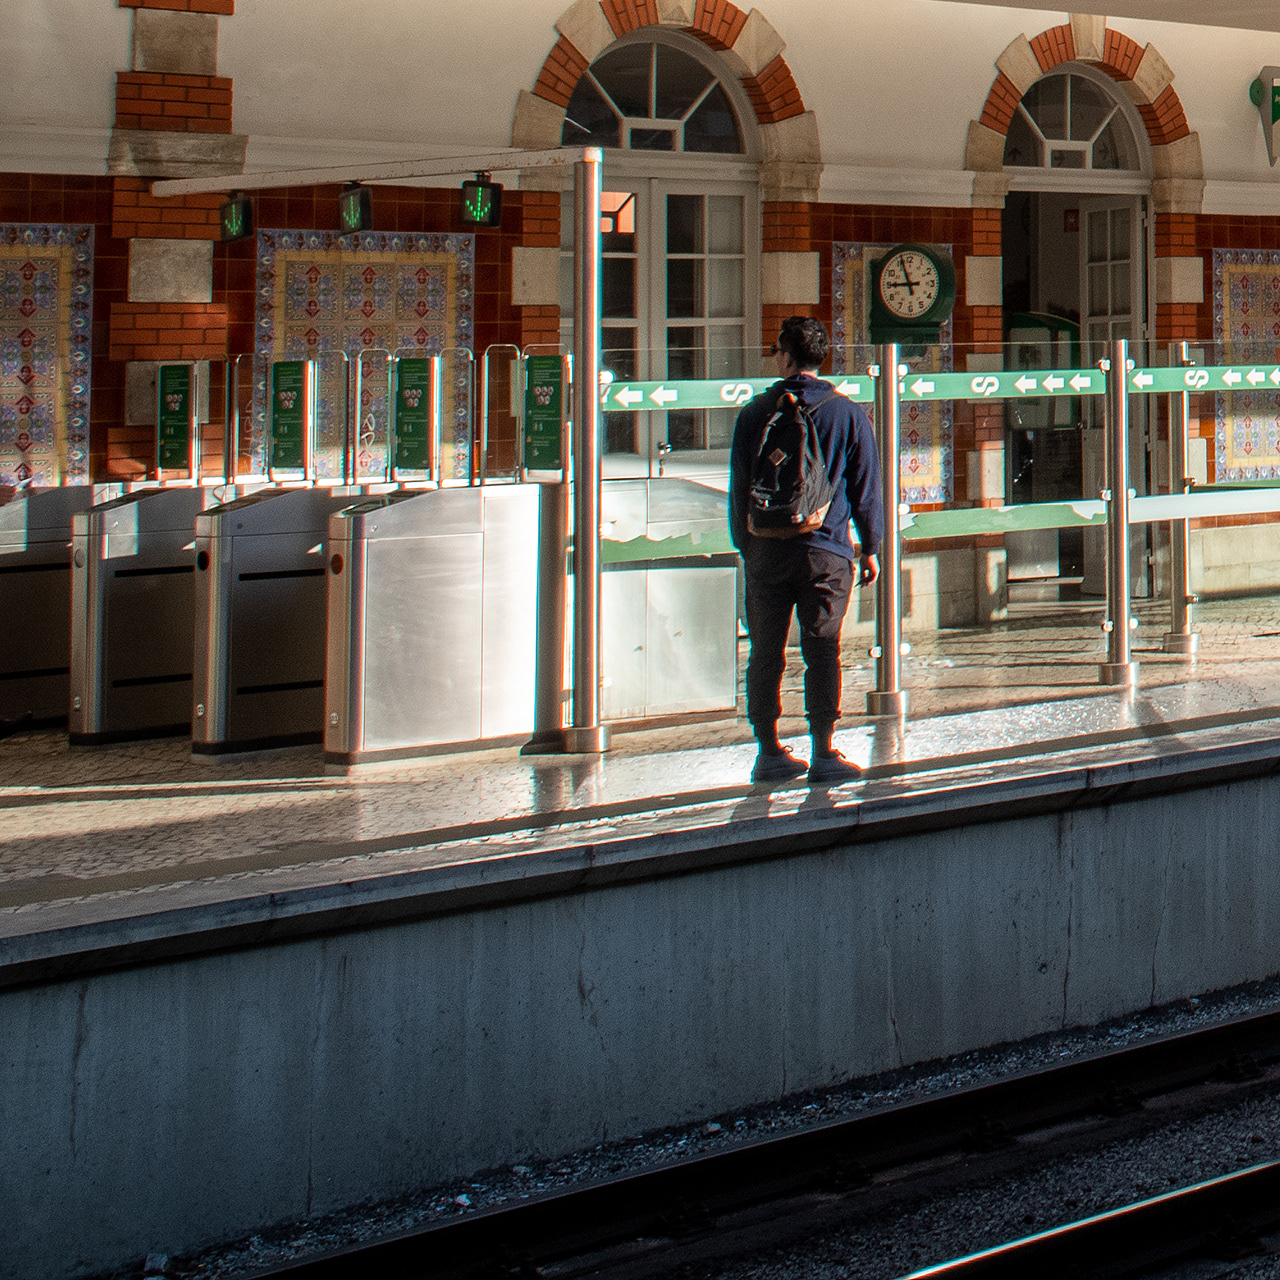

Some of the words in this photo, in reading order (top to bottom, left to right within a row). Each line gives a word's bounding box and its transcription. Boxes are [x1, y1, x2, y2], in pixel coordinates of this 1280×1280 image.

[906, 256, 914, 264] 12
[888, 269, 895, 277] 10
[926, 267, 932, 275] 2
